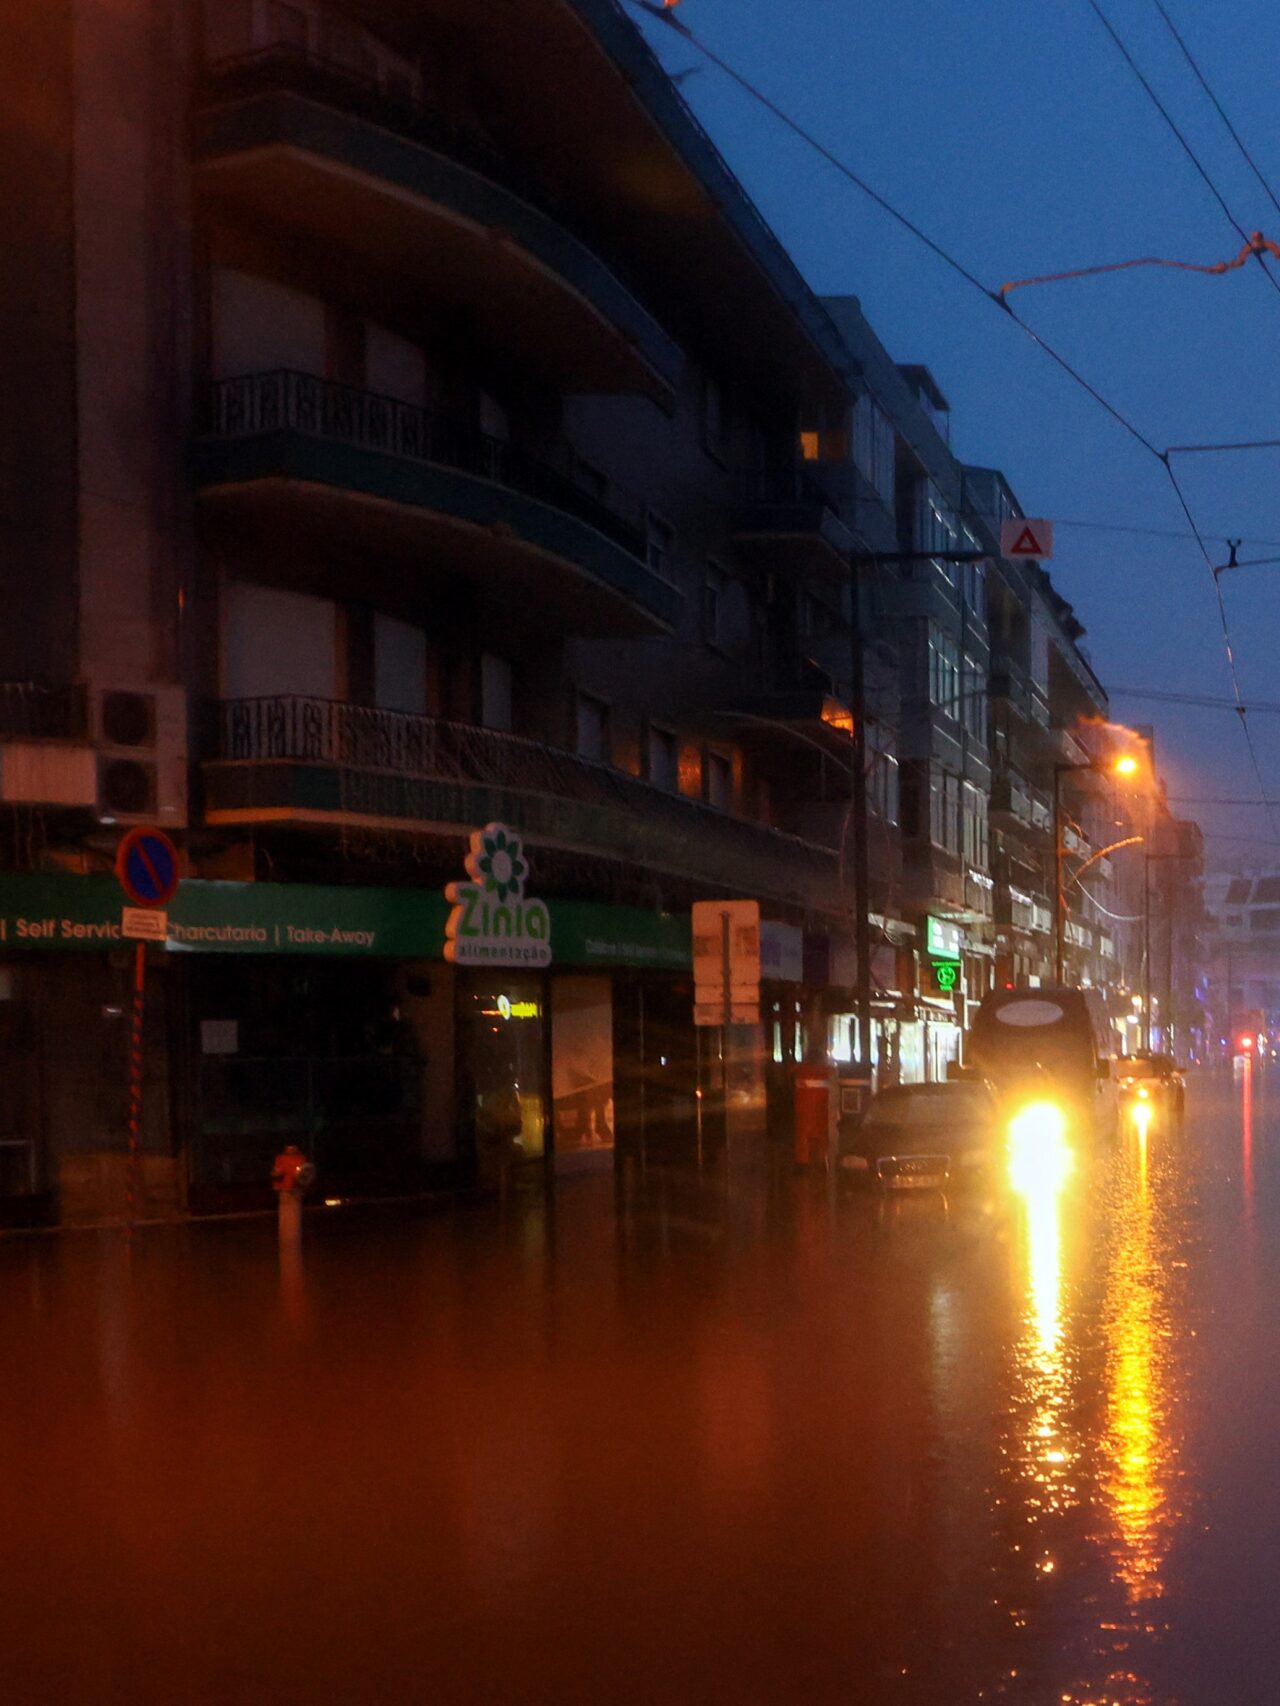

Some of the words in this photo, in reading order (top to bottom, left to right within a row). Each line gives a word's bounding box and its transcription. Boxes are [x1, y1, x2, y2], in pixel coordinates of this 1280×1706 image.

[16, 917, 55, 938] Self
[61, 918, 122, 940] Servic
[287, 924, 375, 947] Take-Away
[459, 887, 545, 940] Zinia
